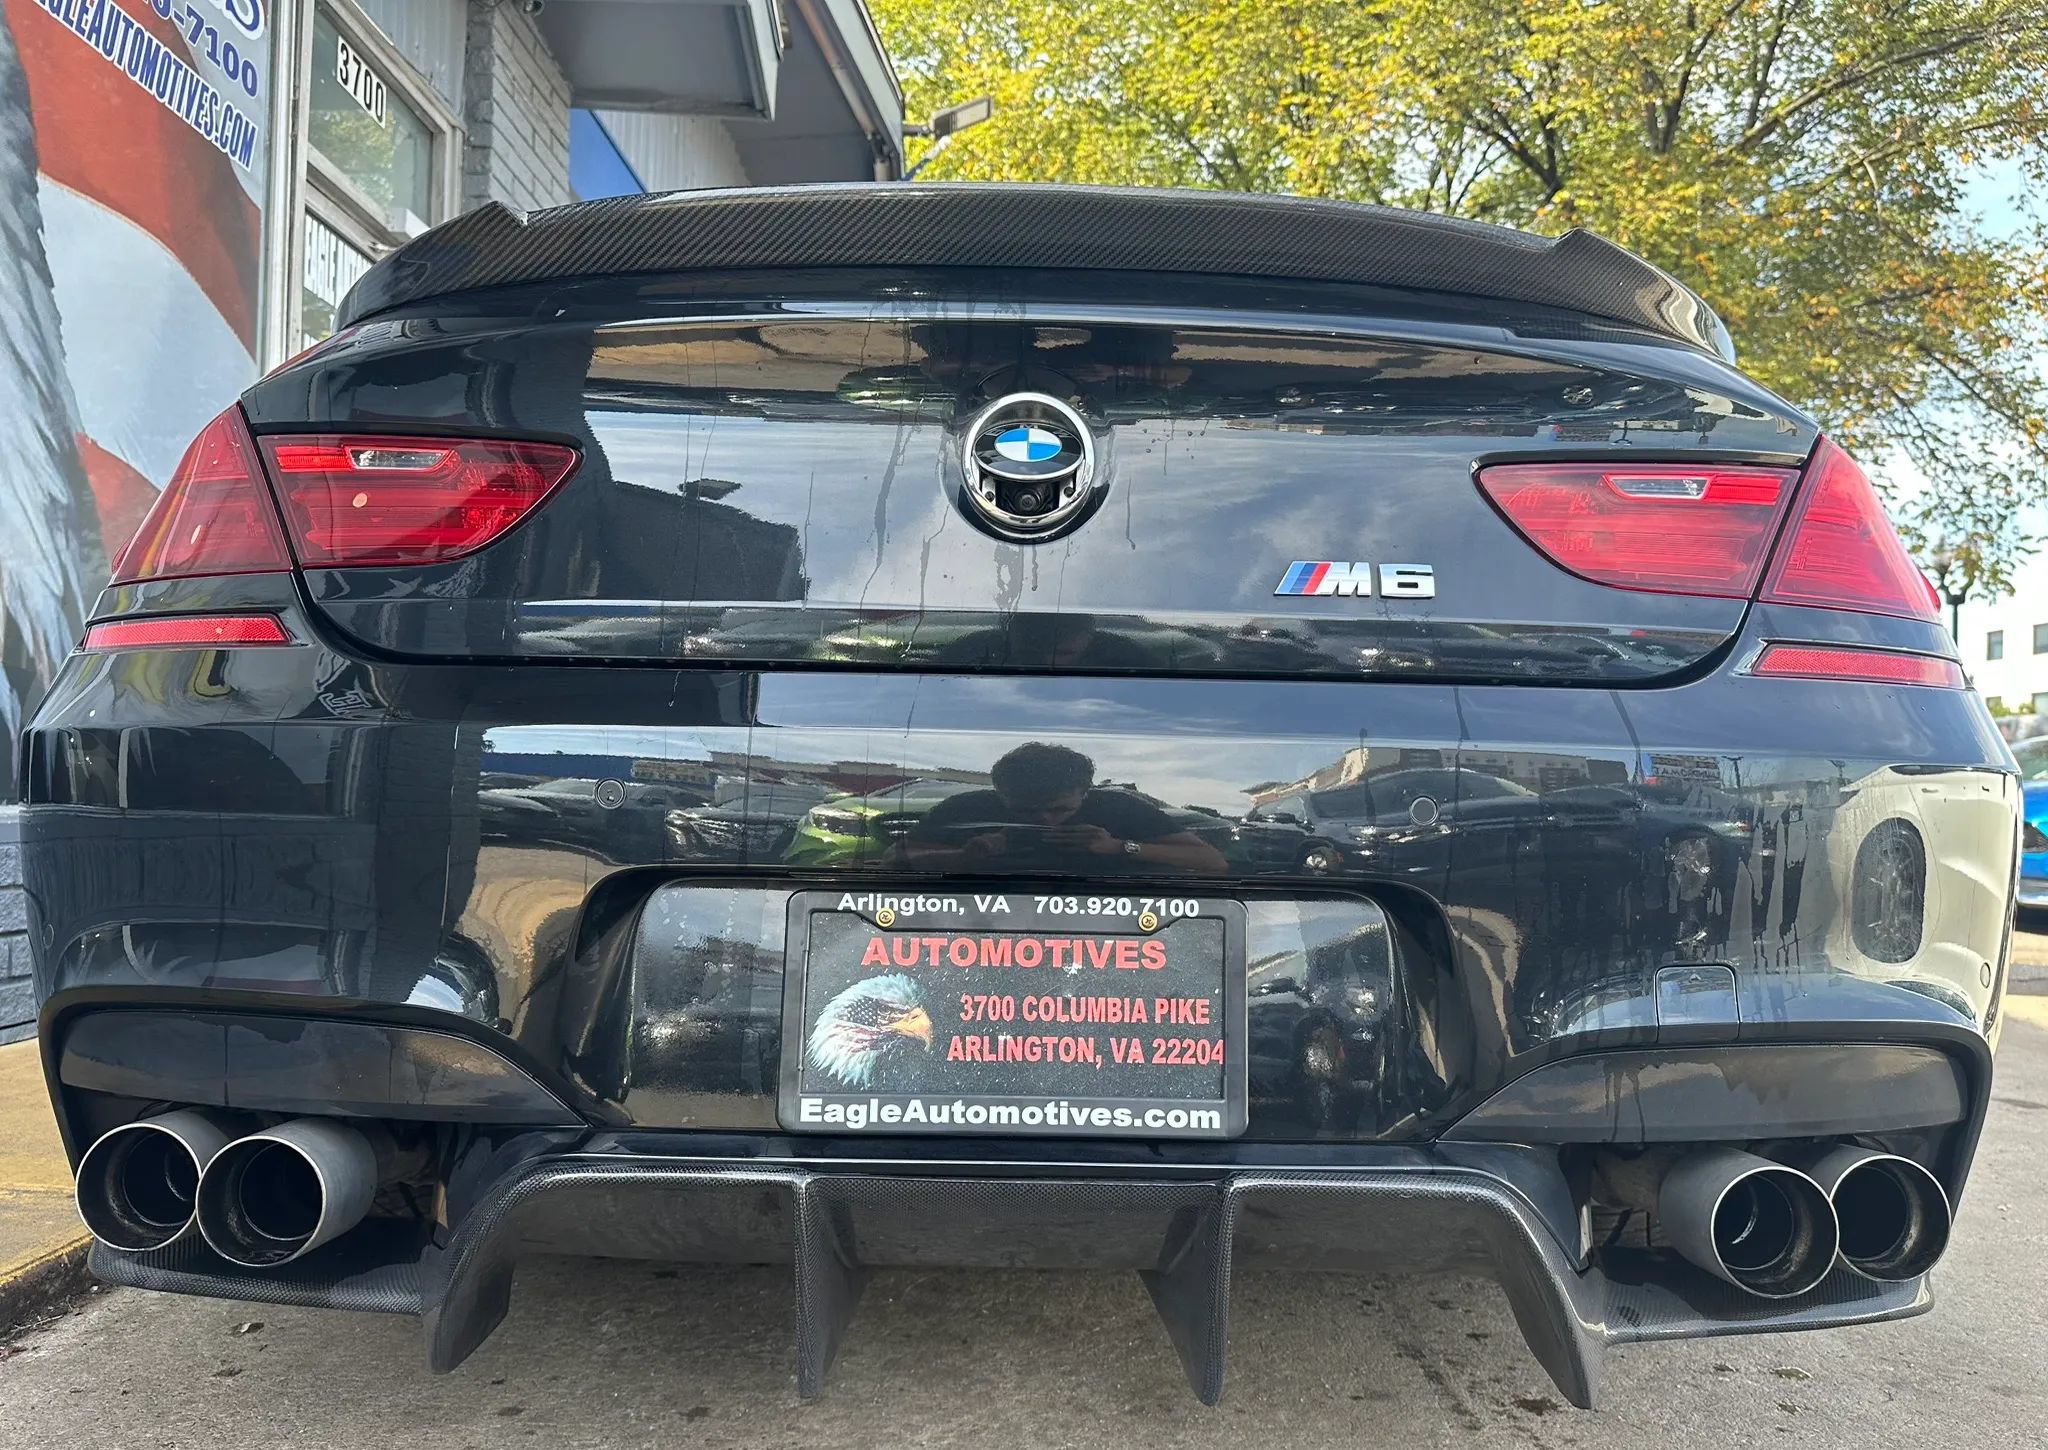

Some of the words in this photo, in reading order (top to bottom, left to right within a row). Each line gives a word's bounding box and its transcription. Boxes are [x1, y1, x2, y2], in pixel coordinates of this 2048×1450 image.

[340, 43, 384, 123] 3700
[1314, 561, 1436, 599] M6
[837, 893, 965, 916] Arlington,
[973, 894, 1011, 913] VA
[1034, 896, 1200, 918] 703.920.7100
[861, 937, 1167, 970] AUTOMOTIVES
[959, 995, 1016, 1022] 3700
[1022, 996, 1148, 1024] COLUMBIA
[1155, 998, 1211, 1025] PIKE
[946, 1035, 1104, 1069] ARLINGTON,
[1109, 1037, 1145, 1065] VA
[1151, 1038, 1224, 1066] 22204
[800, 1098, 1221, 1130] EagleAutomotives.com
